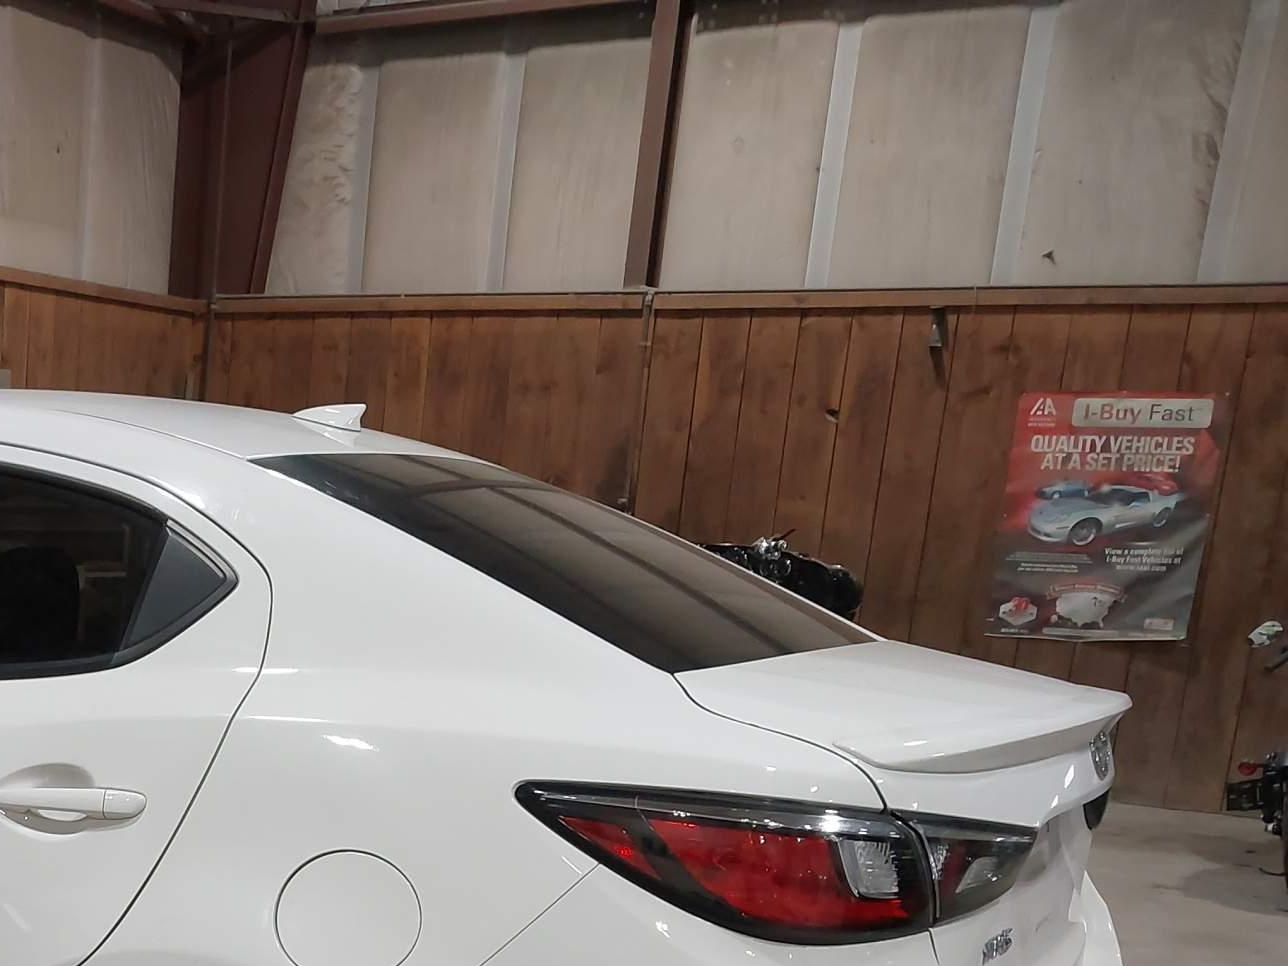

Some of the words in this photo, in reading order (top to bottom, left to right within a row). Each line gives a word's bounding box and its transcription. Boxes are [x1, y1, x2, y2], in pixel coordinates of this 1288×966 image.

[1083, 403, 1143, 425] I-Buy
[1149, 403, 1195, 422] Fast
[1031, 434, 1107, 453] QUALITY
[1110, 435, 1196, 455] VEHICLES
[1040, 453, 1066, 470] AT
[1065, 454, 1081, 470] A
[1085, 453, 1121, 471] SET
[1122, 454, 1182, 473] PRICE!
